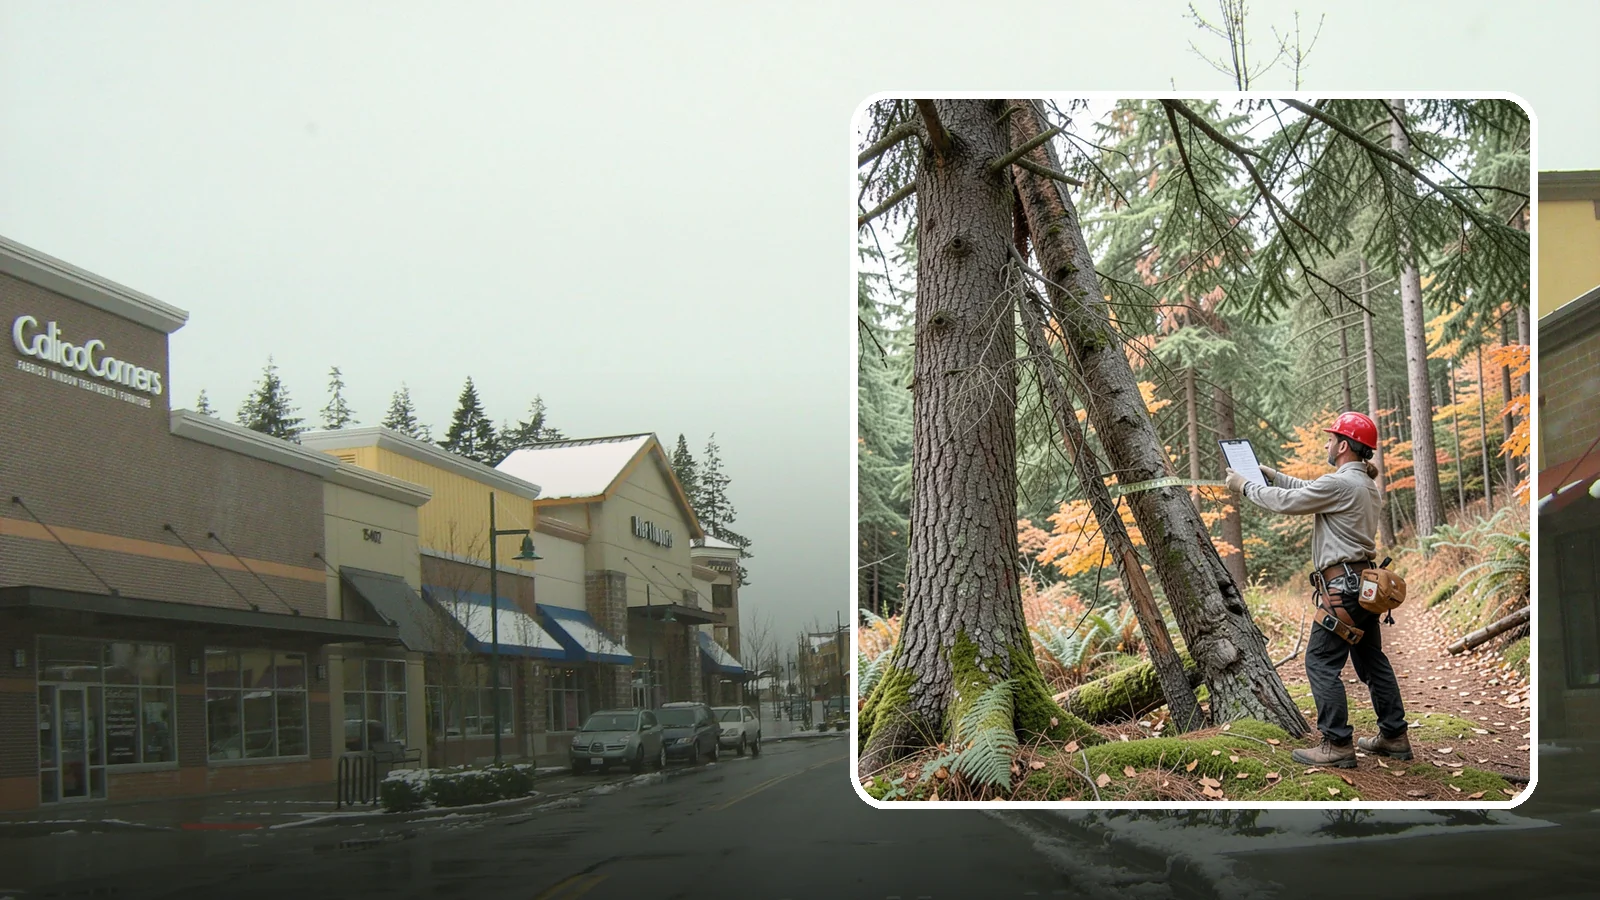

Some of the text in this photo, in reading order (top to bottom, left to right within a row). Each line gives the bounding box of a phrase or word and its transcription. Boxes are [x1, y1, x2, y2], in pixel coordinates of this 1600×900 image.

[17, 360, 47, 377] FABRICS
[51, 370, 78, 387] WINDOW
[78, 378, 116, 398] TREATMENTS
